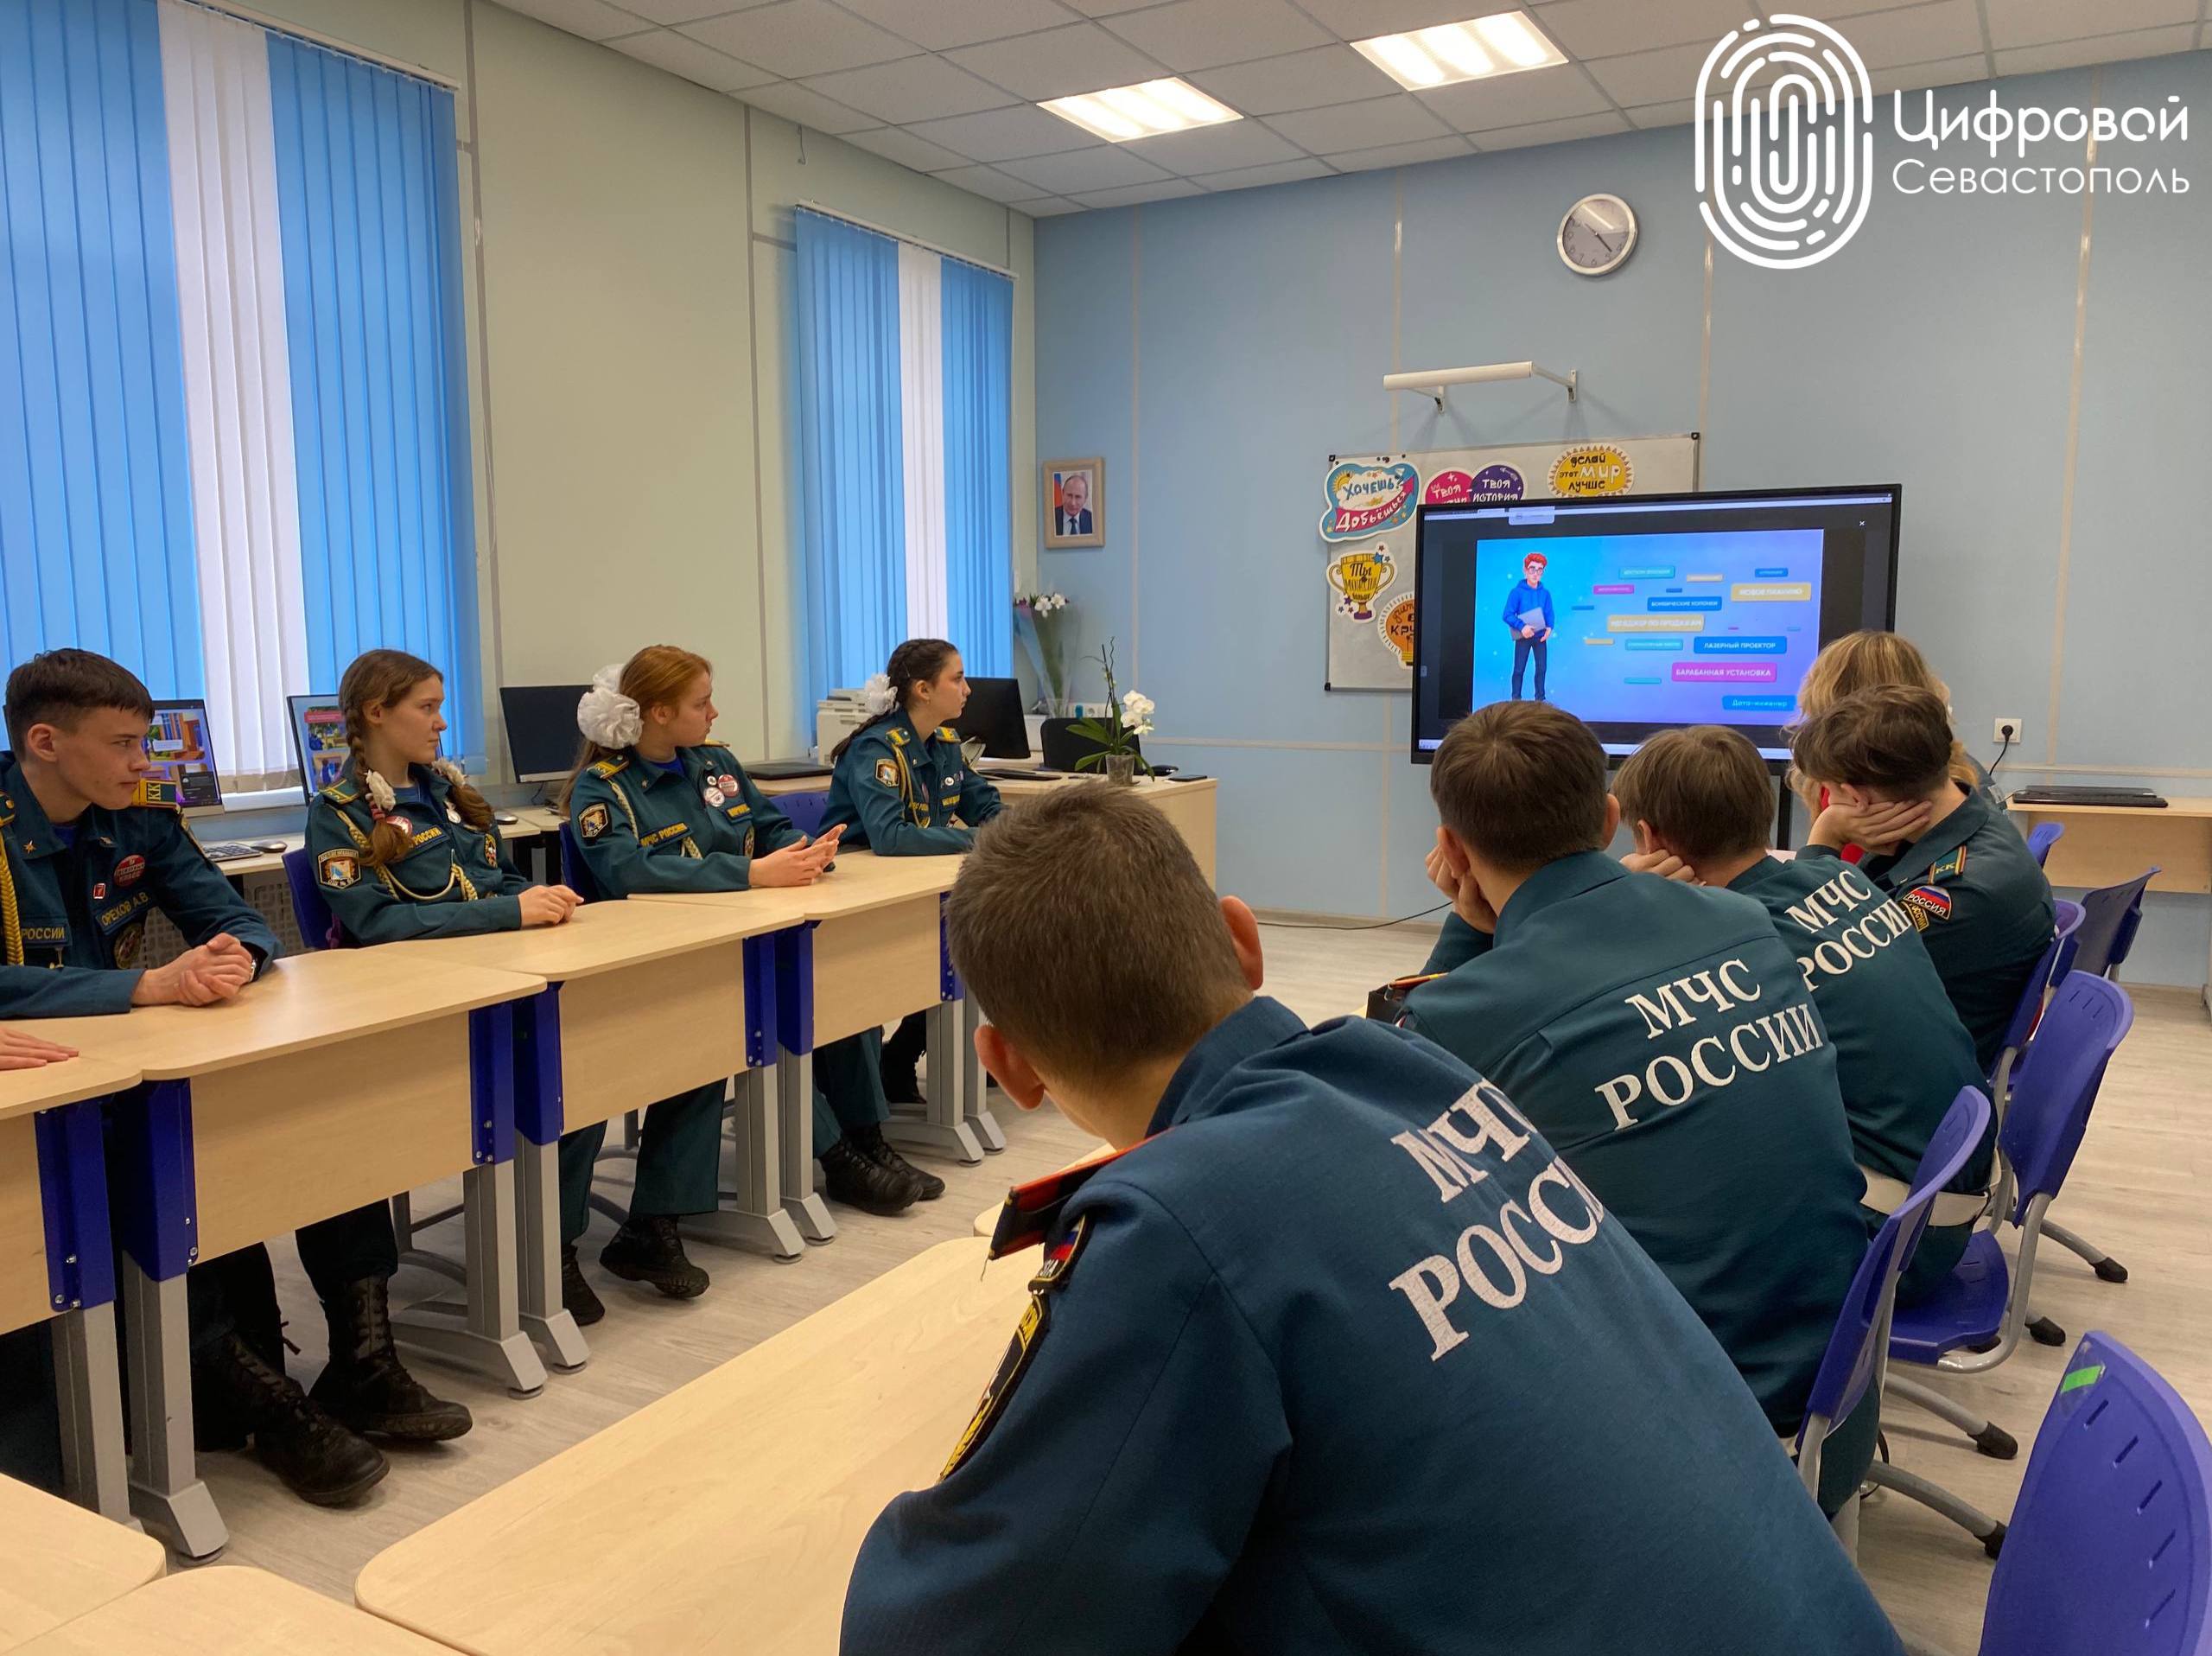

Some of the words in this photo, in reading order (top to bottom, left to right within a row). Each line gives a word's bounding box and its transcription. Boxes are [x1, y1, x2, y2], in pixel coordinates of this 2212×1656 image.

[1433, 485, 1461, 500] ТВОЯ
[1482, 478, 1510, 489] ТВОЯ
[1675, 668, 1725, 677] БАРАБАННАЯ
[1732, 698, 1788, 708] Дата-инженер
[1784, 869, 1872, 933] МЧС
[1907, 893, 1947, 916] РОССИЯ
[21, 926, 65, 940] РОССИИ
[1796, 898, 1912, 992] РОССИ
[1624, 959, 1761, 1040] МЧС
[1594, 1003, 1823, 1131] РОССИИ
[1389, 1156, 1604, 1362] РОСС
